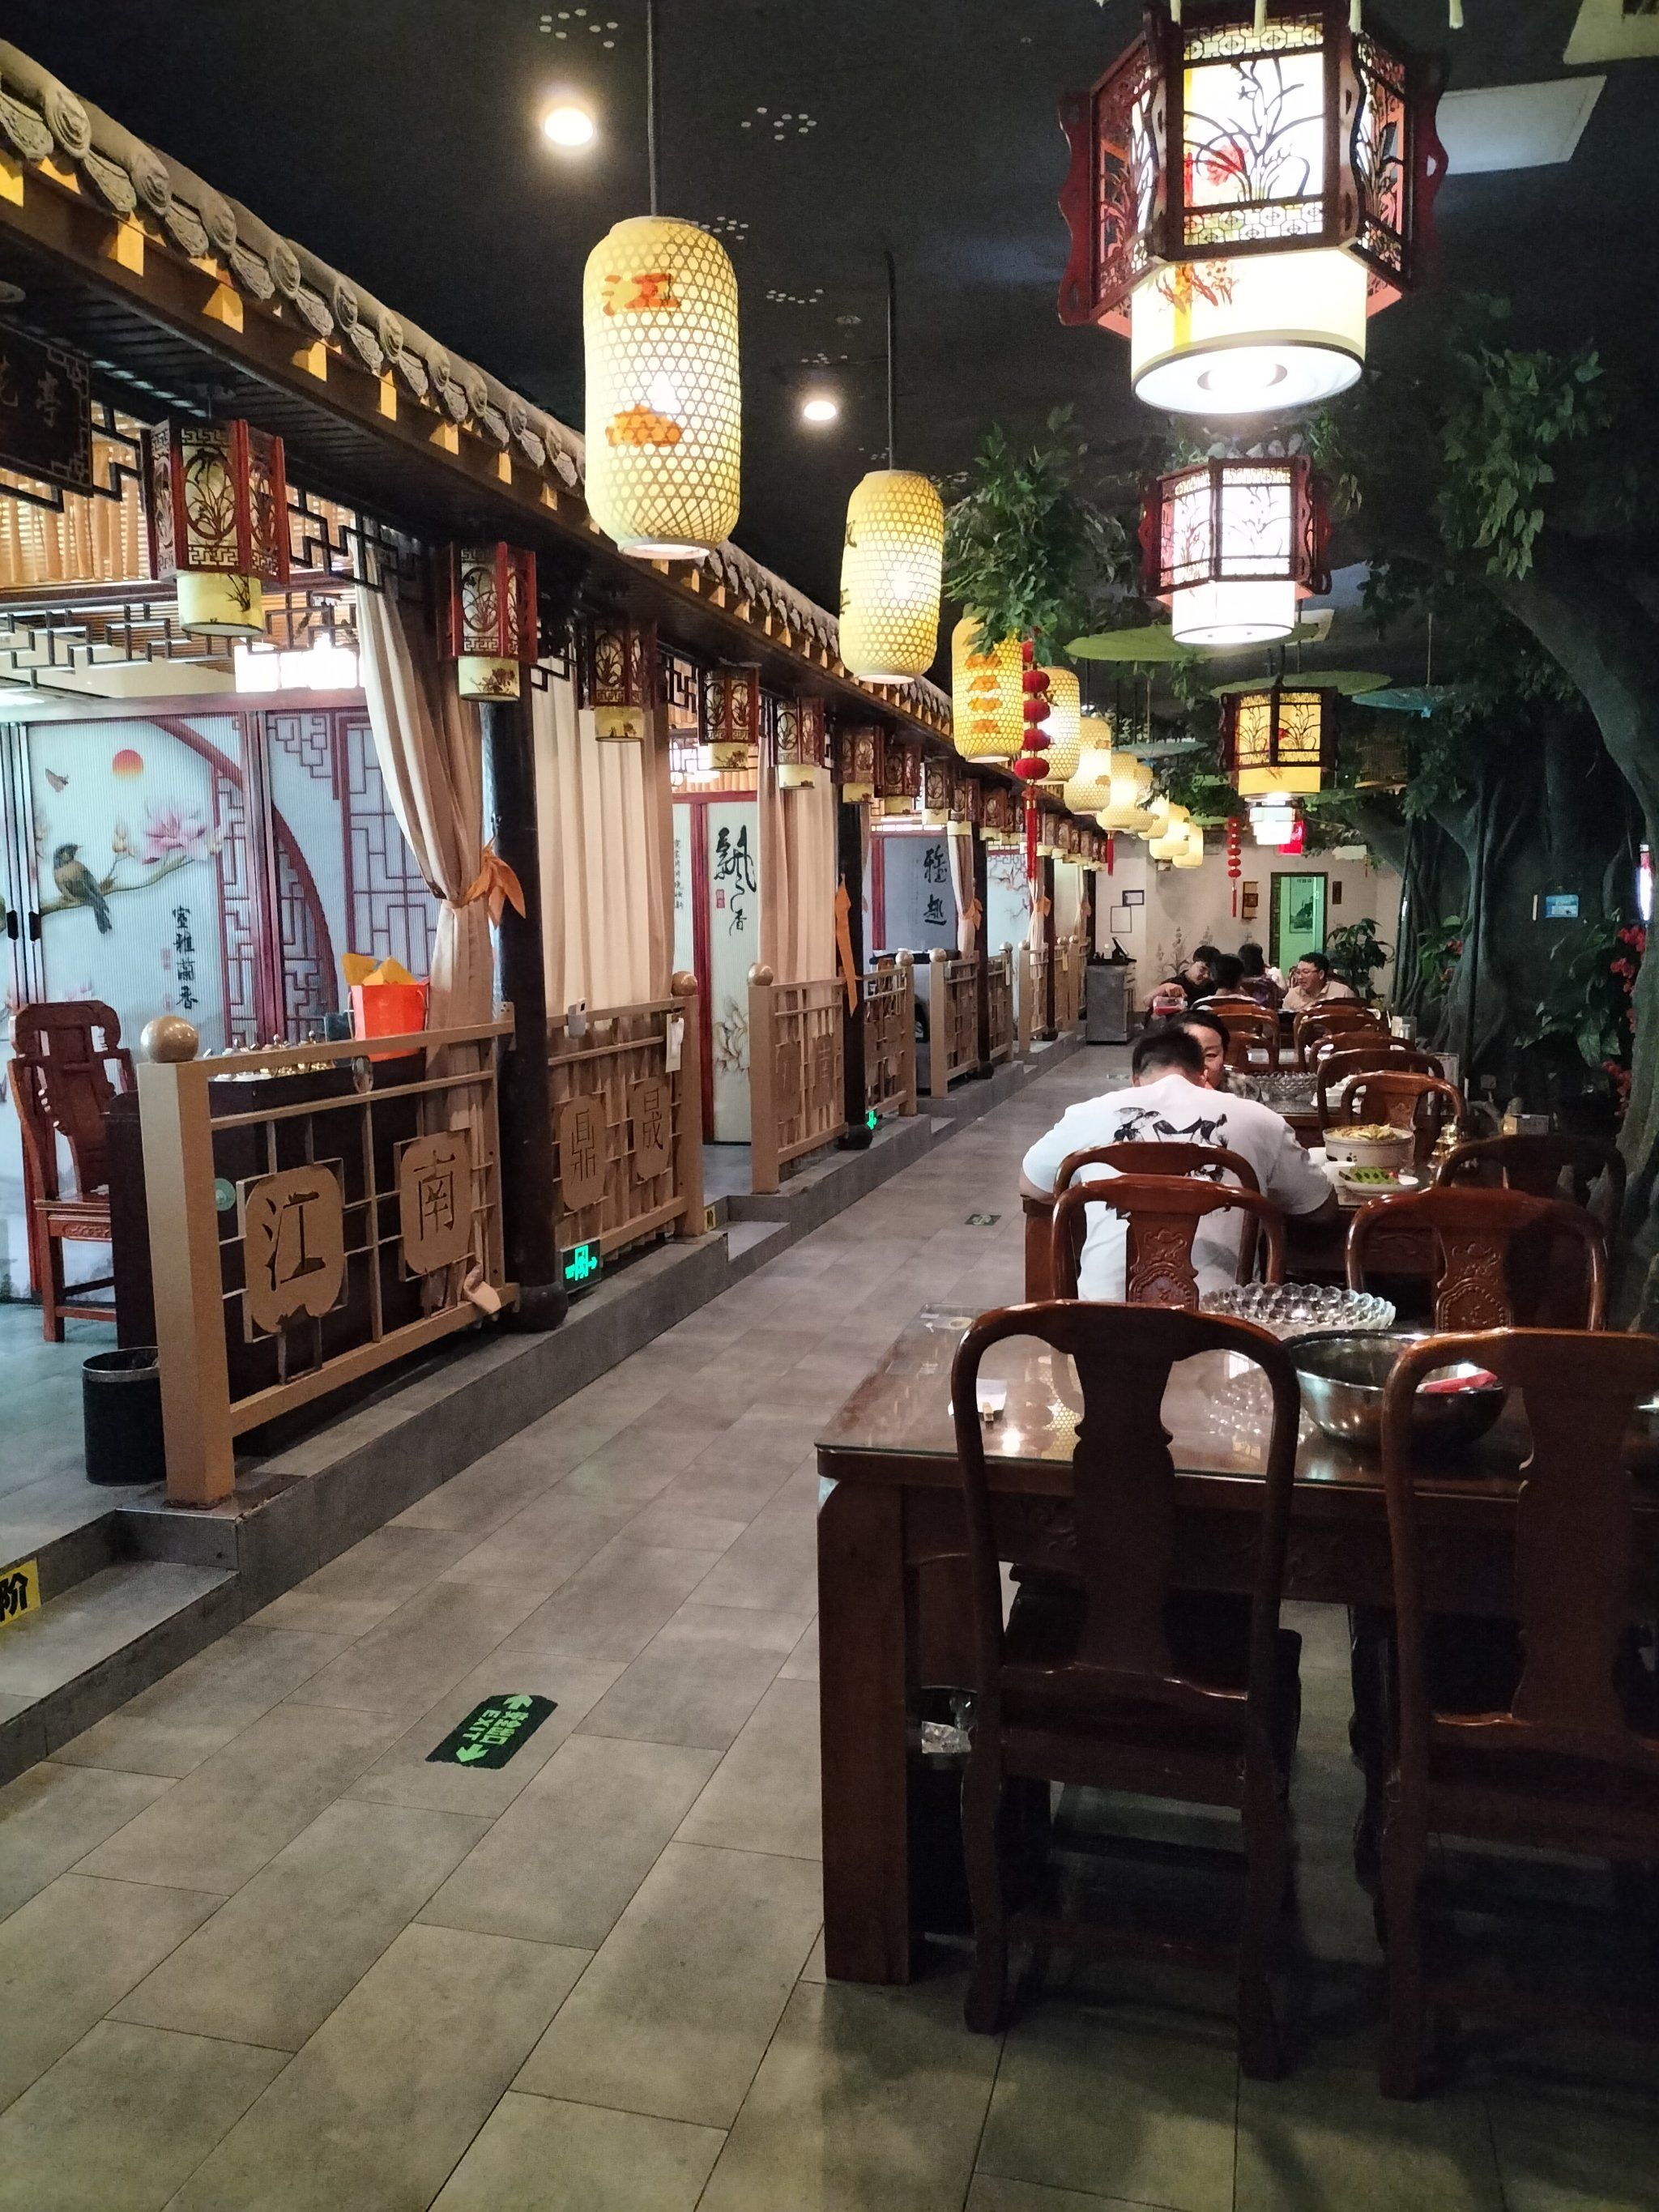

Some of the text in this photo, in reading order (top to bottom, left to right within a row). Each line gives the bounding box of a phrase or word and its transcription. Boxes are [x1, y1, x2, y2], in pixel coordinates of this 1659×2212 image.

[462, 1709, 501, 1741] EXIT
[480, 1711, 529, 1745] 安全出口
